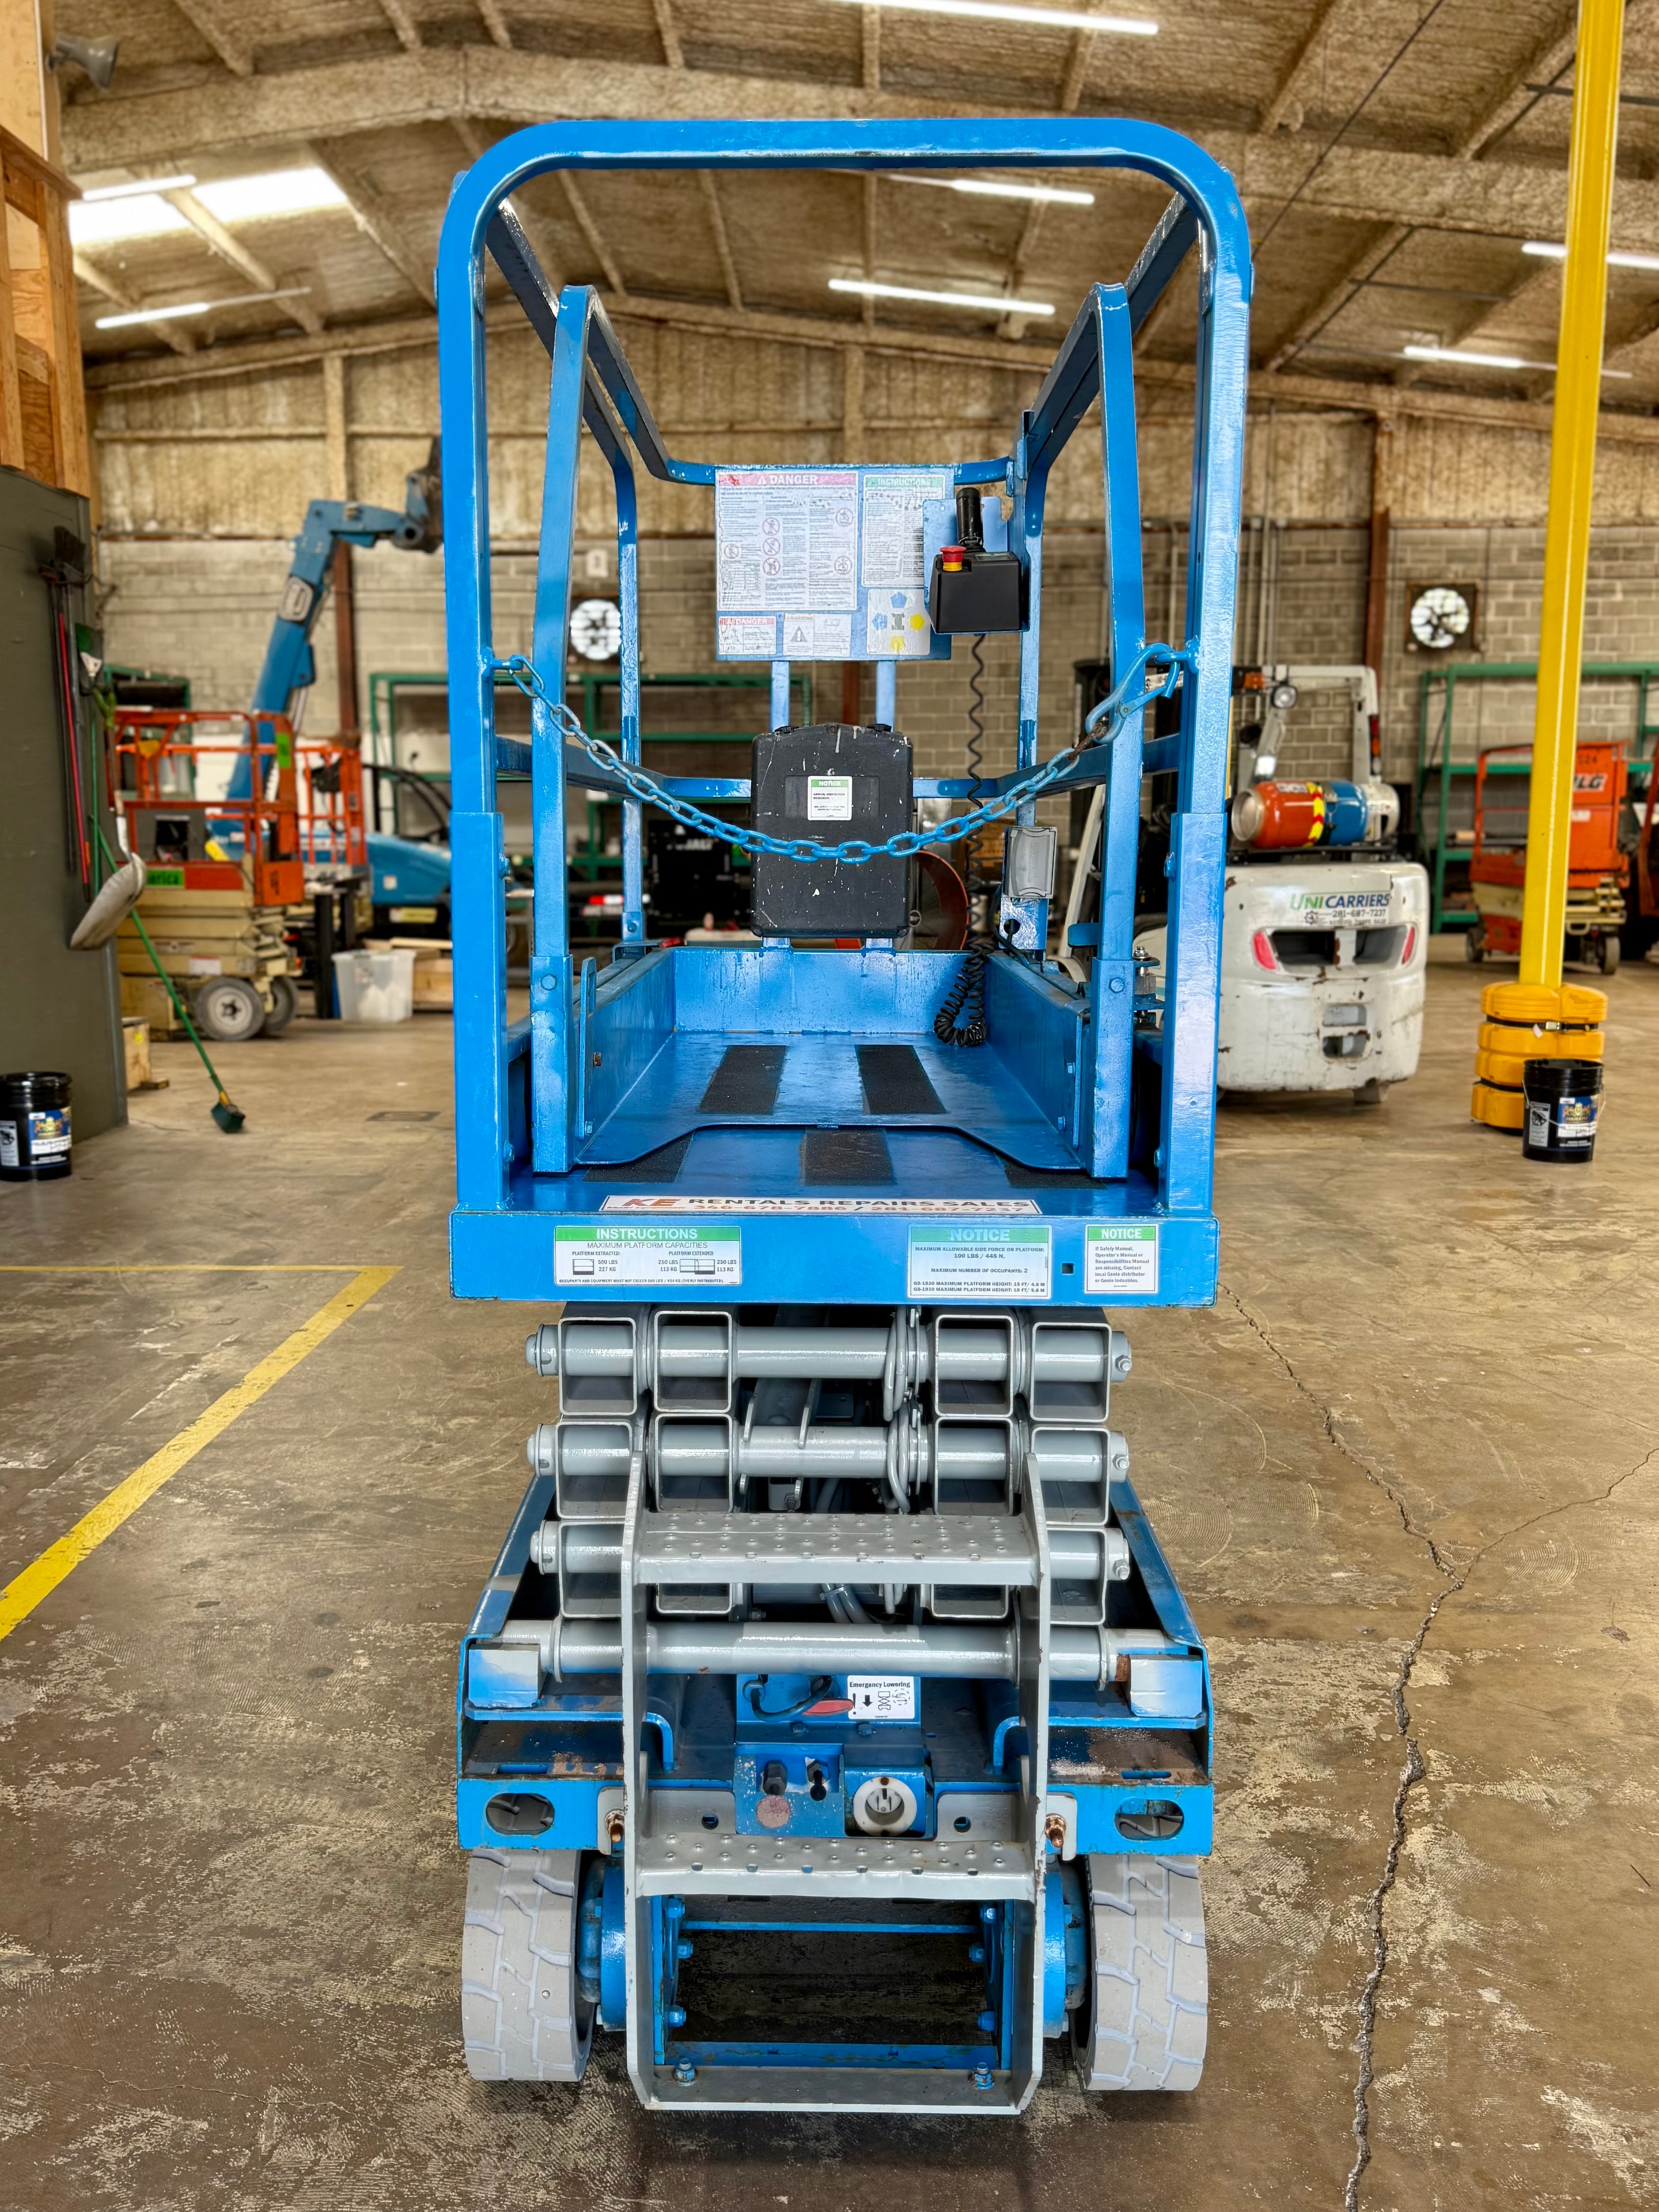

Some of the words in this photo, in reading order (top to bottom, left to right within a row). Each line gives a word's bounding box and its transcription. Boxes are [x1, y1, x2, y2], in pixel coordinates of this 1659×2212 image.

[770, 475, 817, 484] DANGER
[877, 478, 931, 486] INSTRUCTIONS
[148, 870, 179, 885] erica
[1332, 909, 1387, 918] 281-687-7237
[622, 1199, 681, 1207] KE
[596, 1229, 698, 1239] INSTRUCTIONS
[950, 1229, 1010, 1241] NOTICE
[1101, 1228, 1142, 1238] NOTICE
